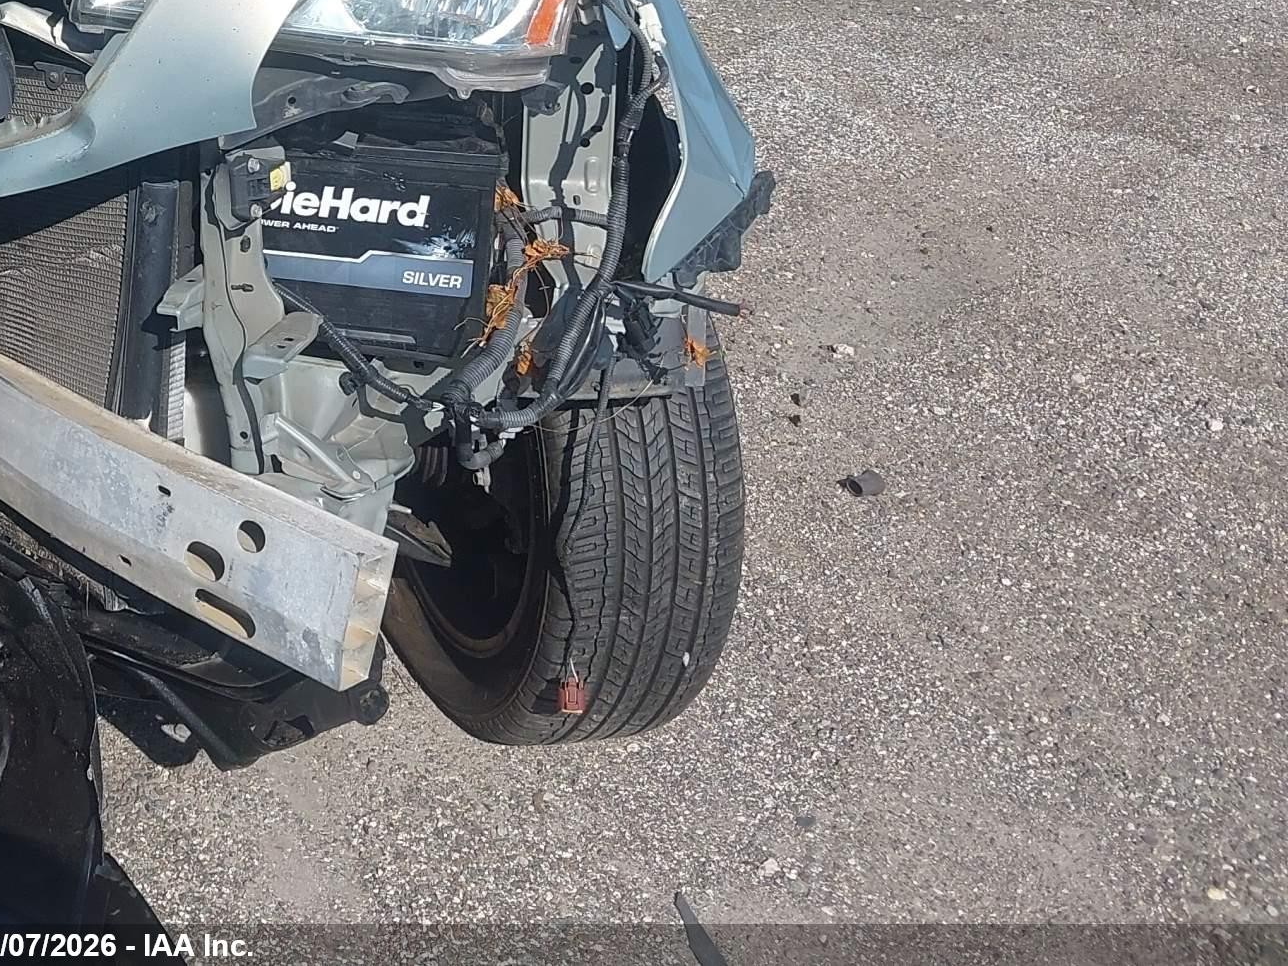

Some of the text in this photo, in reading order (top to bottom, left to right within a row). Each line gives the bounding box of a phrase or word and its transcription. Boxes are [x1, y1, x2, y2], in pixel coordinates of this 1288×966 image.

[260, 219, 336, 233] WER AHEAD
[402, 270, 462, 289] SILVER
